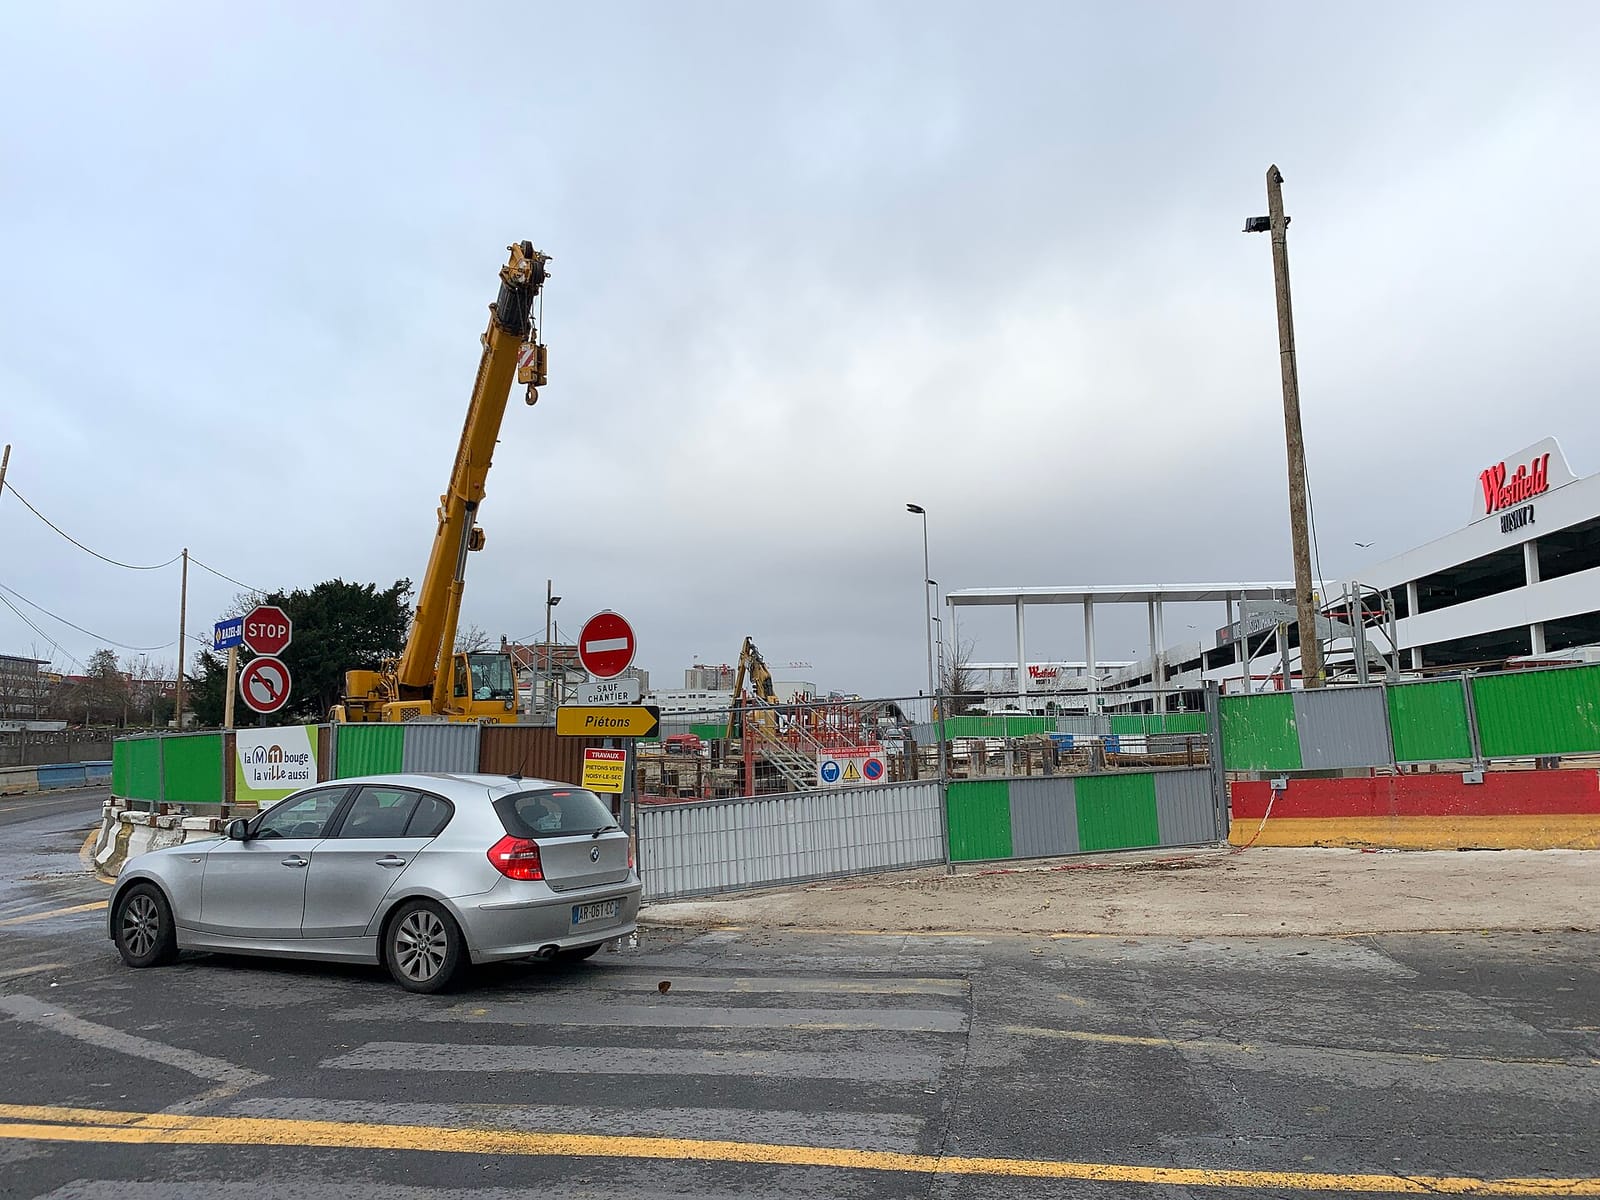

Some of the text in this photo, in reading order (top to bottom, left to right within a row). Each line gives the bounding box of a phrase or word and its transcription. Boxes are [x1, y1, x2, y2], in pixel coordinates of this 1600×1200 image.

[1480, 453, 1550, 514] Westfield
[1500, 504, 1535, 533] ROSNY 2
[248, 623, 287, 638] STOP
[1028, 665, 1057, 678] Westfield
[597, 683, 618, 692] SAUF
[588, 692, 629, 702] CHANTIER
[585, 715, 631, 727] Piétons
[244, 752, 252, 764] la
[284, 751, 309, 766] bouge
[254, 765, 309, 781] la ville aussi
